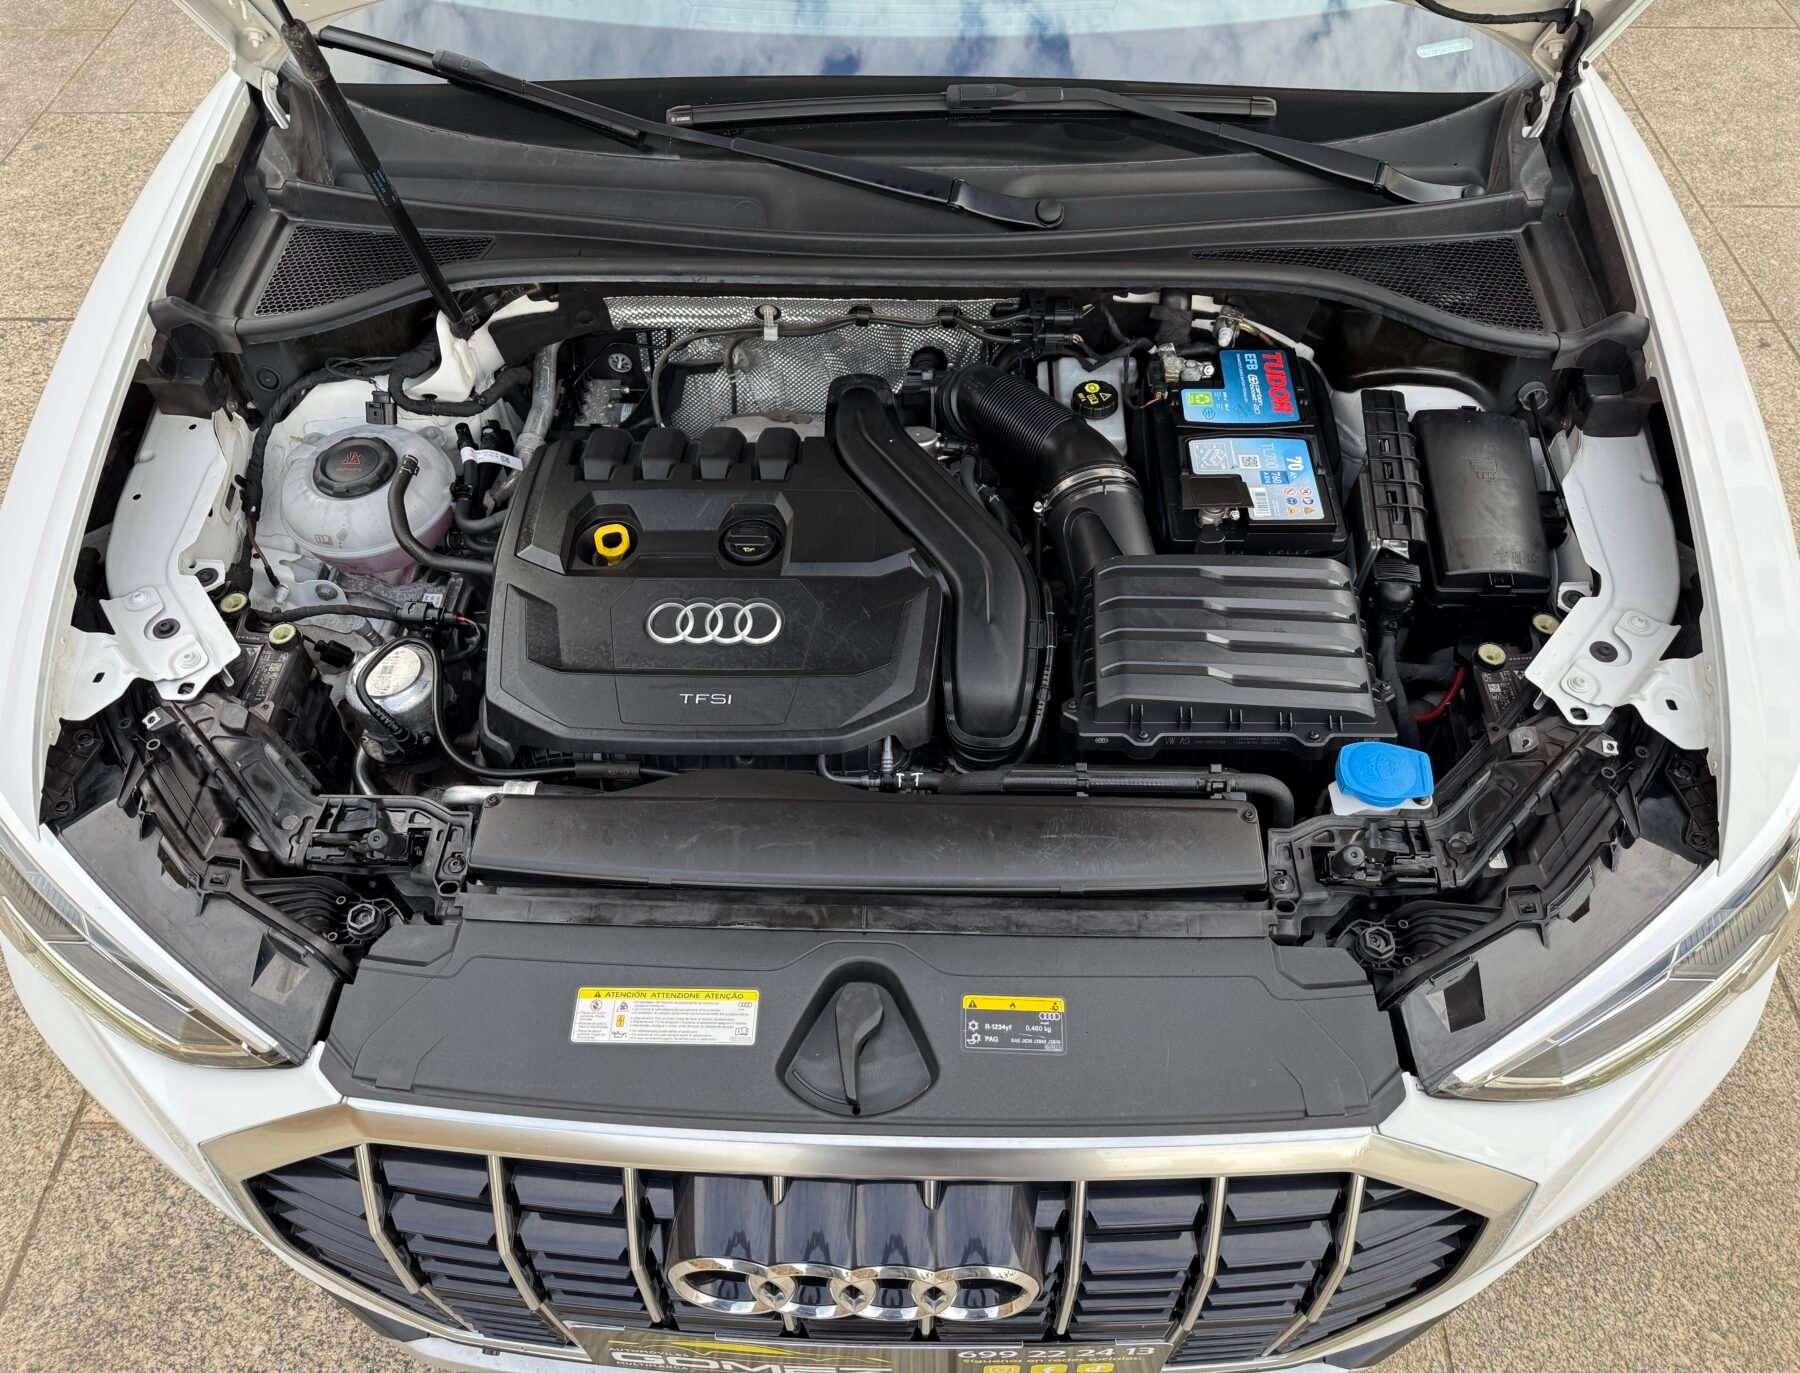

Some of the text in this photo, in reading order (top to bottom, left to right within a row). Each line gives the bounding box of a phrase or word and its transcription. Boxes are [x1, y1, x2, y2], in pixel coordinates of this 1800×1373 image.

[1244, 353, 1258, 371] EFB
[1262, 351, 1293, 414] TUDOR
[1285, 455, 1304, 471] 70
[1270, 471, 1282, 484] 760
[679, 693, 732, 705] TFSI
[650, 991, 700, 999] ATTENZIONE
[704, 991, 744, 1000] ATENÇÃO
[984, 1023, 1012, 1031] R-1234yf
[984, 1035, 999, 1043] PAG
[958, 1347, 1155, 1359] 699 22 24 13
